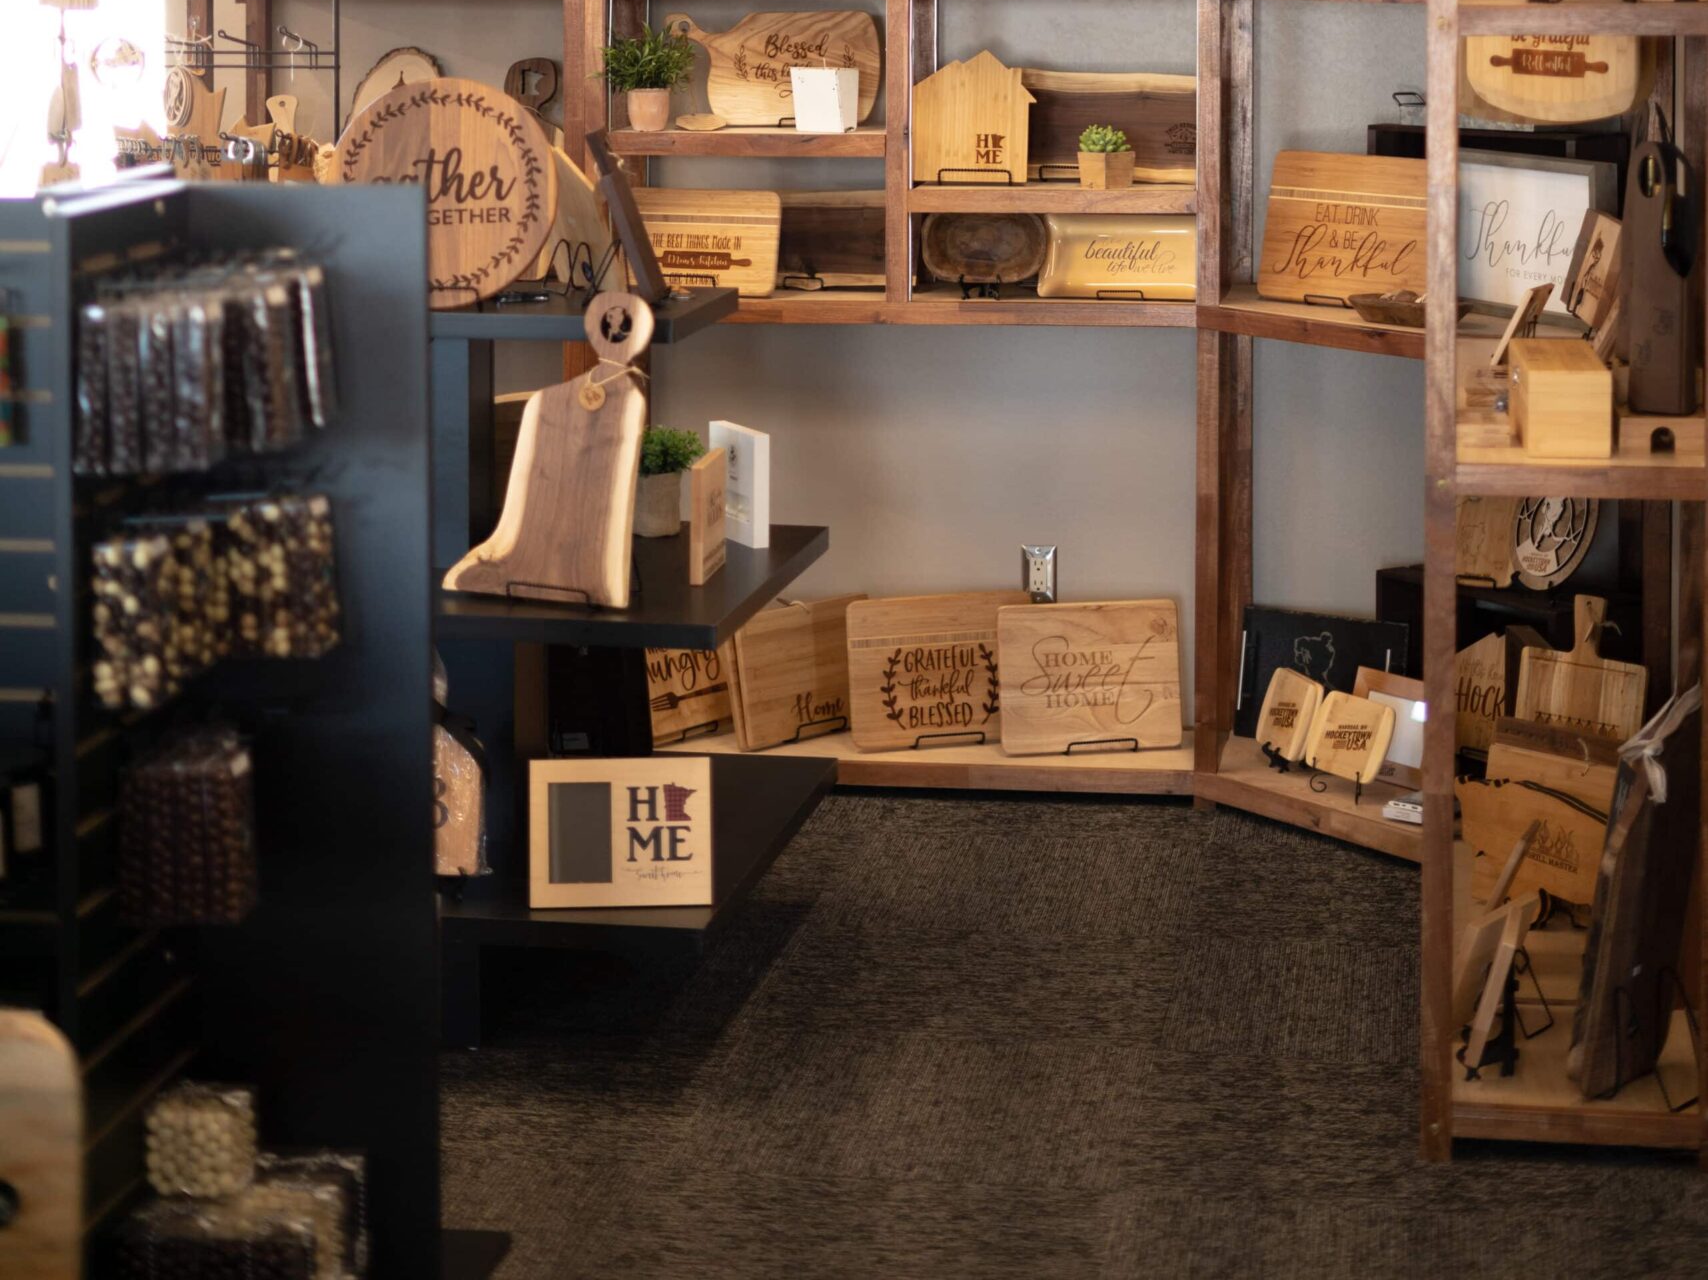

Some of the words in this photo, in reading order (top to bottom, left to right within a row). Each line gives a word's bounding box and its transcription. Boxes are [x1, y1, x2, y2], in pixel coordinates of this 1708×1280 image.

[764, 33, 829, 59] Blessed
[750, 63, 777, 81] this
[372, 147, 516, 204] ther
[428, 207, 511, 226] GETHER
[1345, 206, 1379, 226] DRINK
[667, 233, 683, 248] BEST
[734, 236, 742, 250] IN
[1329, 229, 1339, 248] &
[1343, 231, 1359, 250] BE
[1465, 199, 1574, 268] Thankfu
[1084, 240, 1160, 270] beautiful
[1272, 224, 1417, 279] Thankful
[1506, 267, 1520, 278] FOR
[1524, 271, 1548, 281] EVERY
[646, 649, 720, 691] ungry
[904, 645, 979, 672] GRATEFUL
[1043, 651, 1113, 668] HOME
[898, 669, 975, 703] thankful
[1020, 635, 1156, 724] Sweet
[790, 691, 845, 723] Home
[1046, 692, 1115, 708] HOME
[909, 701, 973, 729] BLESSED
[1325, 730, 1372, 740] HOCKEYTOWN
[1346, 739, 1367, 751] USA
